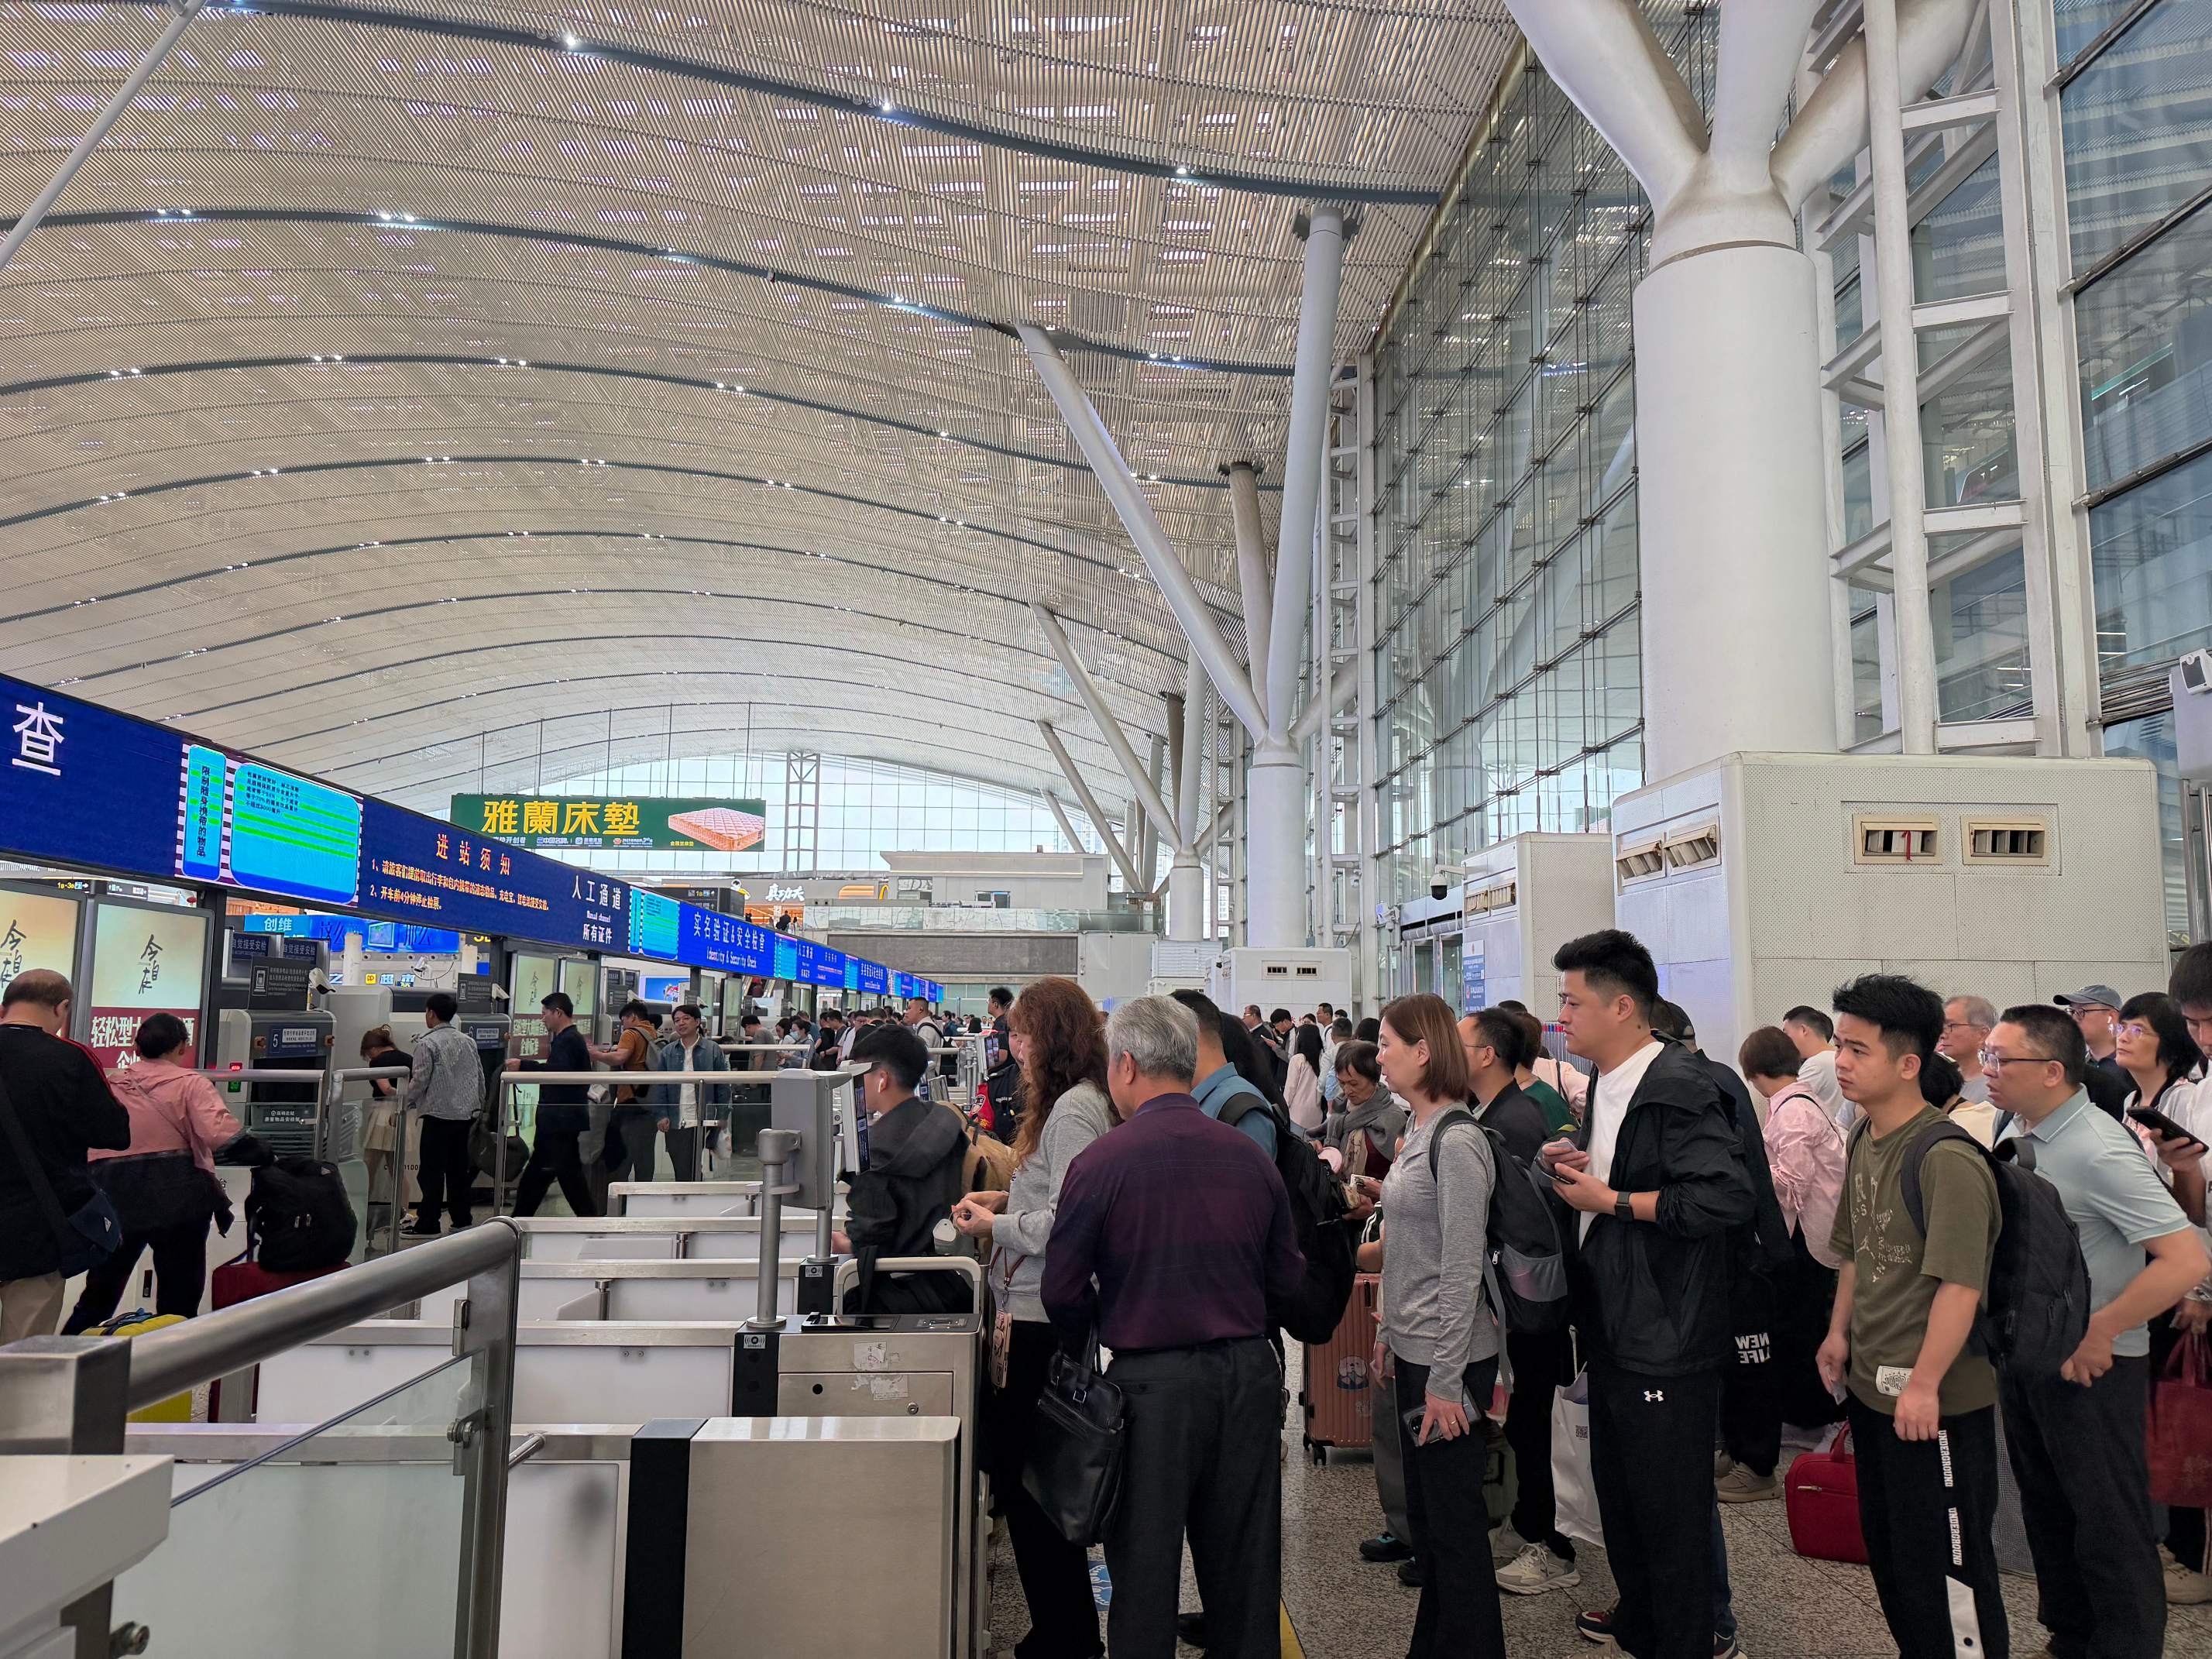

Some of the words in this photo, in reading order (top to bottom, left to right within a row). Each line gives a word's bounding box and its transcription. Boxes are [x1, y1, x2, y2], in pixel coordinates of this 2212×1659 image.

[12, 701, 64, 776] 查
[481, 799, 641, 835] 雅蘭床墊
[436, 833, 511, 876] 进站须知
[572, 875, 621, 910] 人工通道
[765, 883, 805, 902] 真功夫
[264, 917, 292, 931] 创维
[582, 923, 613, 944] 所有证件
[693, 911, 765, 953] 实名验证&安全检查
[706, 946, 725, 964] Identity
[730, 951, 746, 968] Security
[273, 1033, 279, 1048] 5
[1938, 1430, 1954, 1487] UNDERGROUND
[1948, 1506, 1963, 1566] UNDERGROUND
